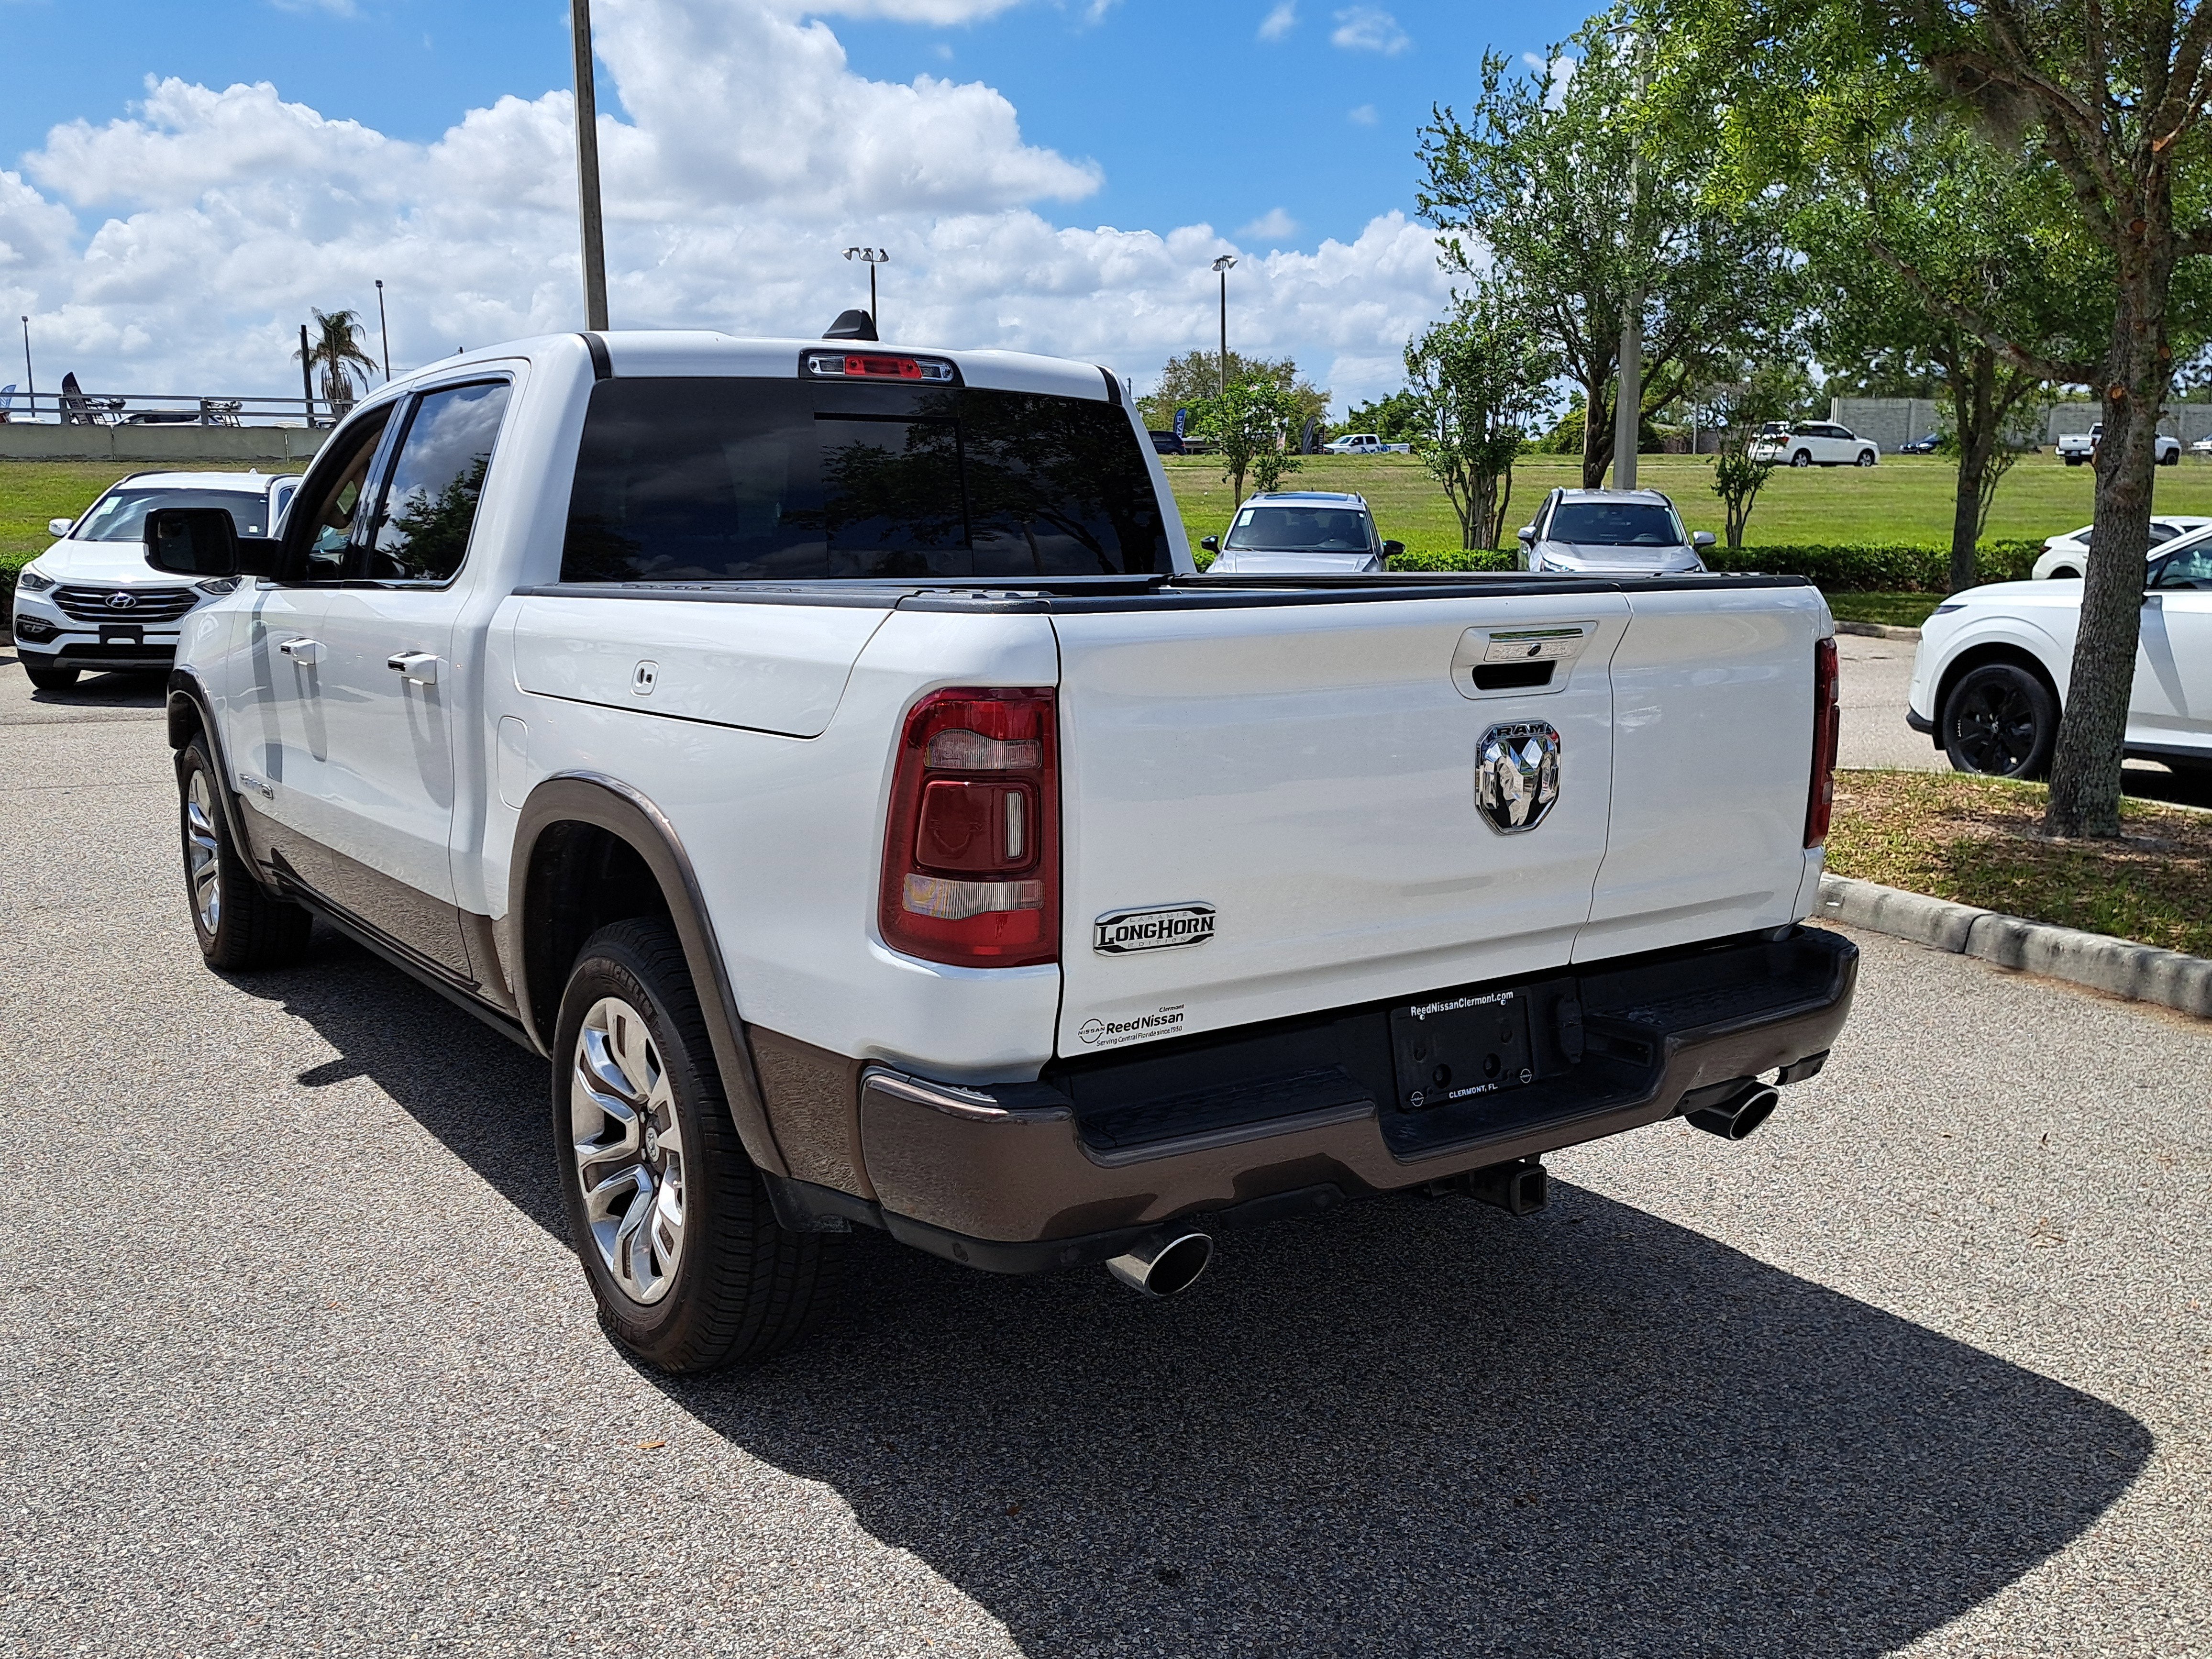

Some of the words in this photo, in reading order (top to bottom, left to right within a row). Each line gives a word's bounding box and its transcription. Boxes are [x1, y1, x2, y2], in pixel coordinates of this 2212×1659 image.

[1497, 724, 1546, 737] RAM
[1129, 911, 1188, 923] LARAMIE
[1128, 936, 1187, 948] EDITION
[1159, 1004, 1185, 1013] Clermont
[1411, 991, 1514, 1017] ReedNissanClermont.com
[1106, 1018, 1140, 1035] Reed
[1141, 1012, 1184, 1028] Nissan
[1078, 1026, 1106, 1036] NISSAN
[1096, 1038, 1117, 1047] Serving
[1118, 1033, 1138, 1043] Central
[1138, 1030, 1156, 1040] Florida
[1157, 1028, 1171, 1036] since
[1449, 1084, 1487, 1099] CLERMONT,
